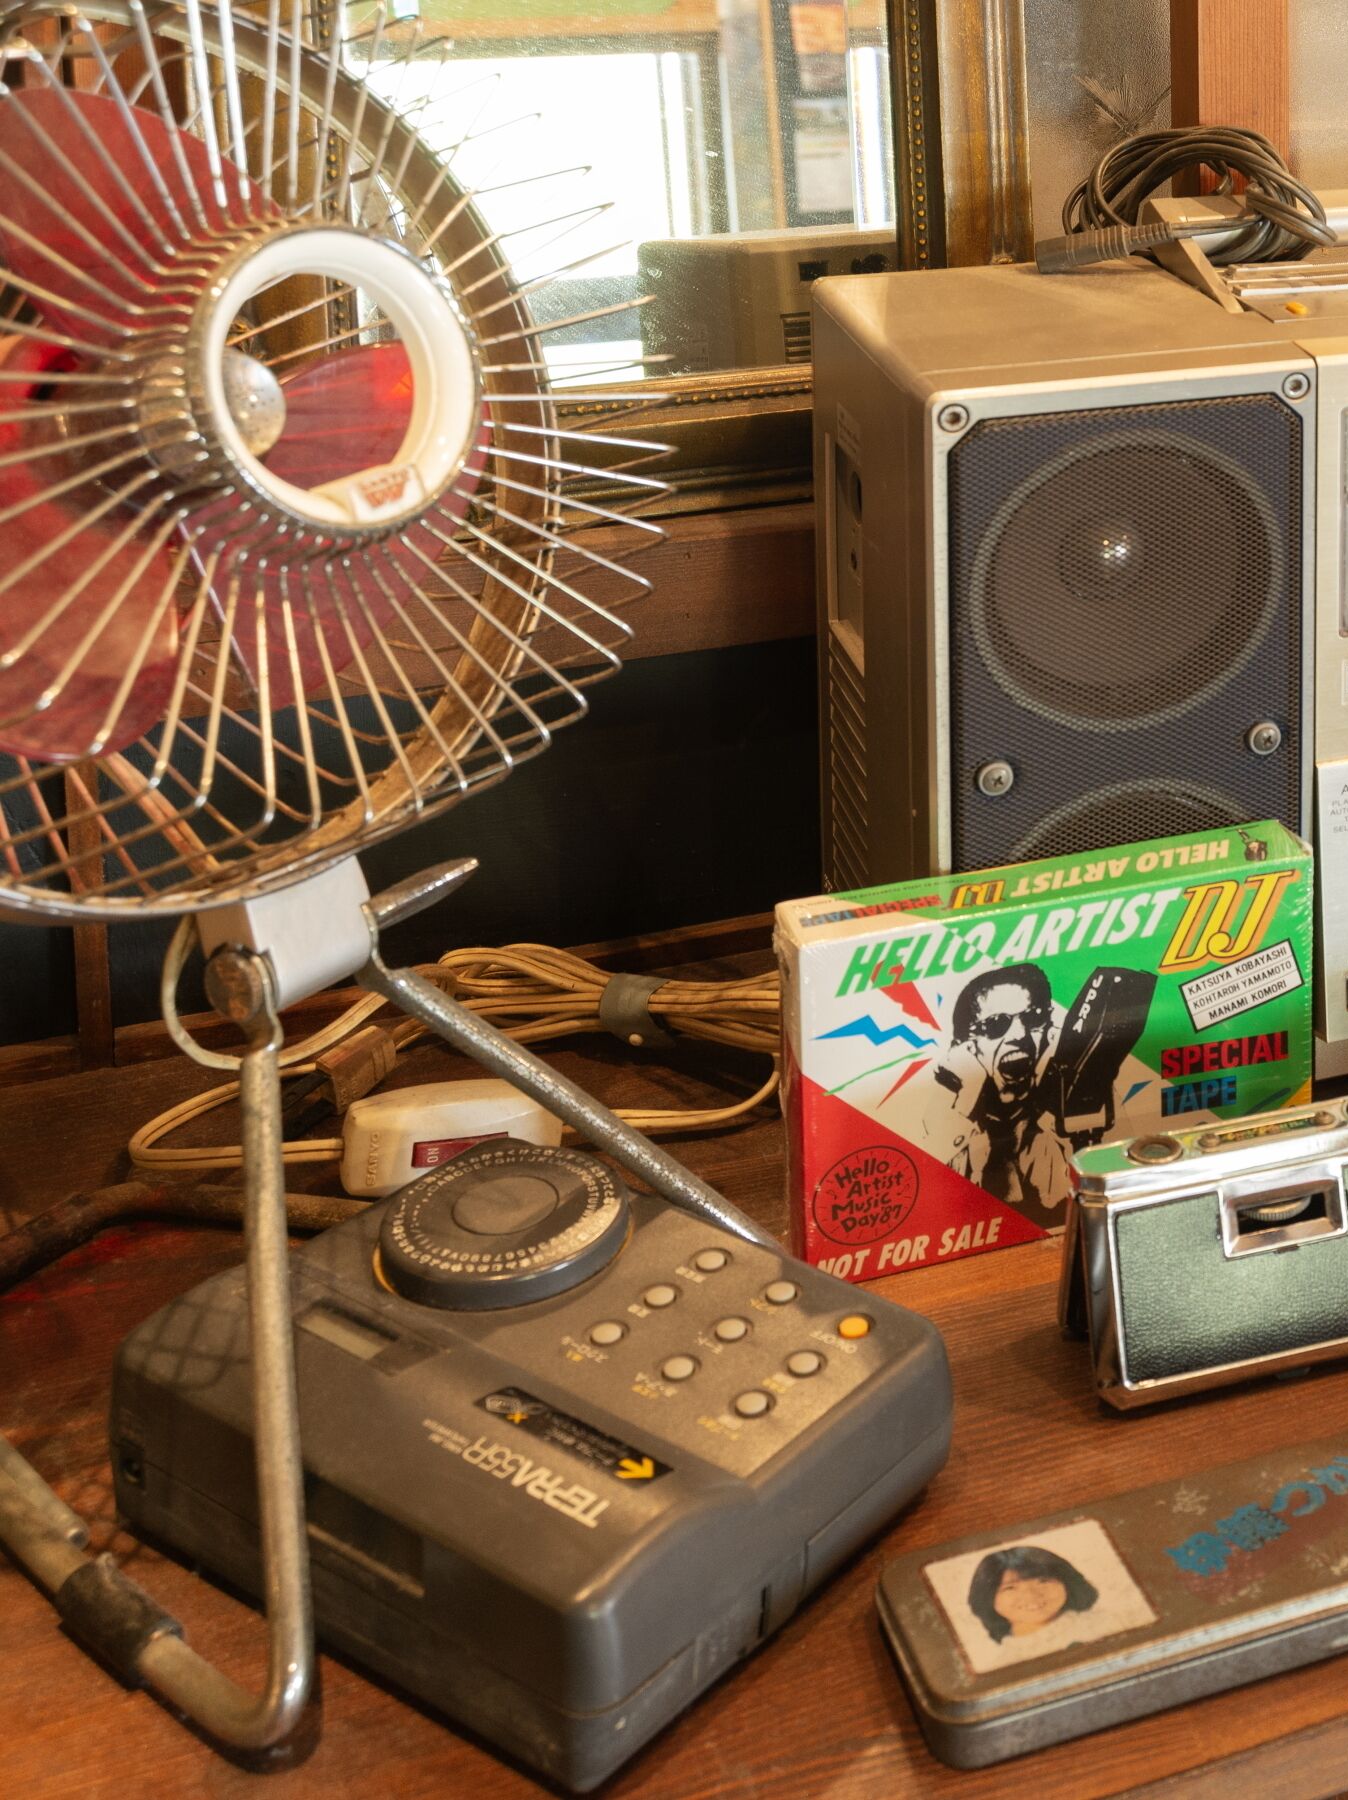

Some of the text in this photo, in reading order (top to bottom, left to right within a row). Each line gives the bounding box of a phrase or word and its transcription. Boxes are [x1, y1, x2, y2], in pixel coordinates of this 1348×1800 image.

[1136, 839, 1230, 872] HELLO
[950, 879, 1006, 910] DJ
[1010, 856, 1130, 897] ARTIST
[854, 895, 943, 919] SPECIAL
[835, 869, 1301, 997] HELLO ARTIST DJ
[1187, 947, 1288, 995] KATSUYA KOBAYASHI
[1193, 961, 1292, 1009] KOHTAROH YAMAMOTO
[1208, 980, 1287, 1020] MANAMI KOMORI
[1162, 1031, 1289, 1079] SPECIAL
[1162, 1076, 1236, 1117] TAPE
[366, 1132, 382, 1187] SANYO
[427, 1147, 440, 1164] ON
[835, 1158, 890, 1188] Hello
[847, 1172, 903, 1198] Artist
[831, 1192, 892, 1220] Music
[817, 1217, 1003, 1280] NOT FOR SALE
